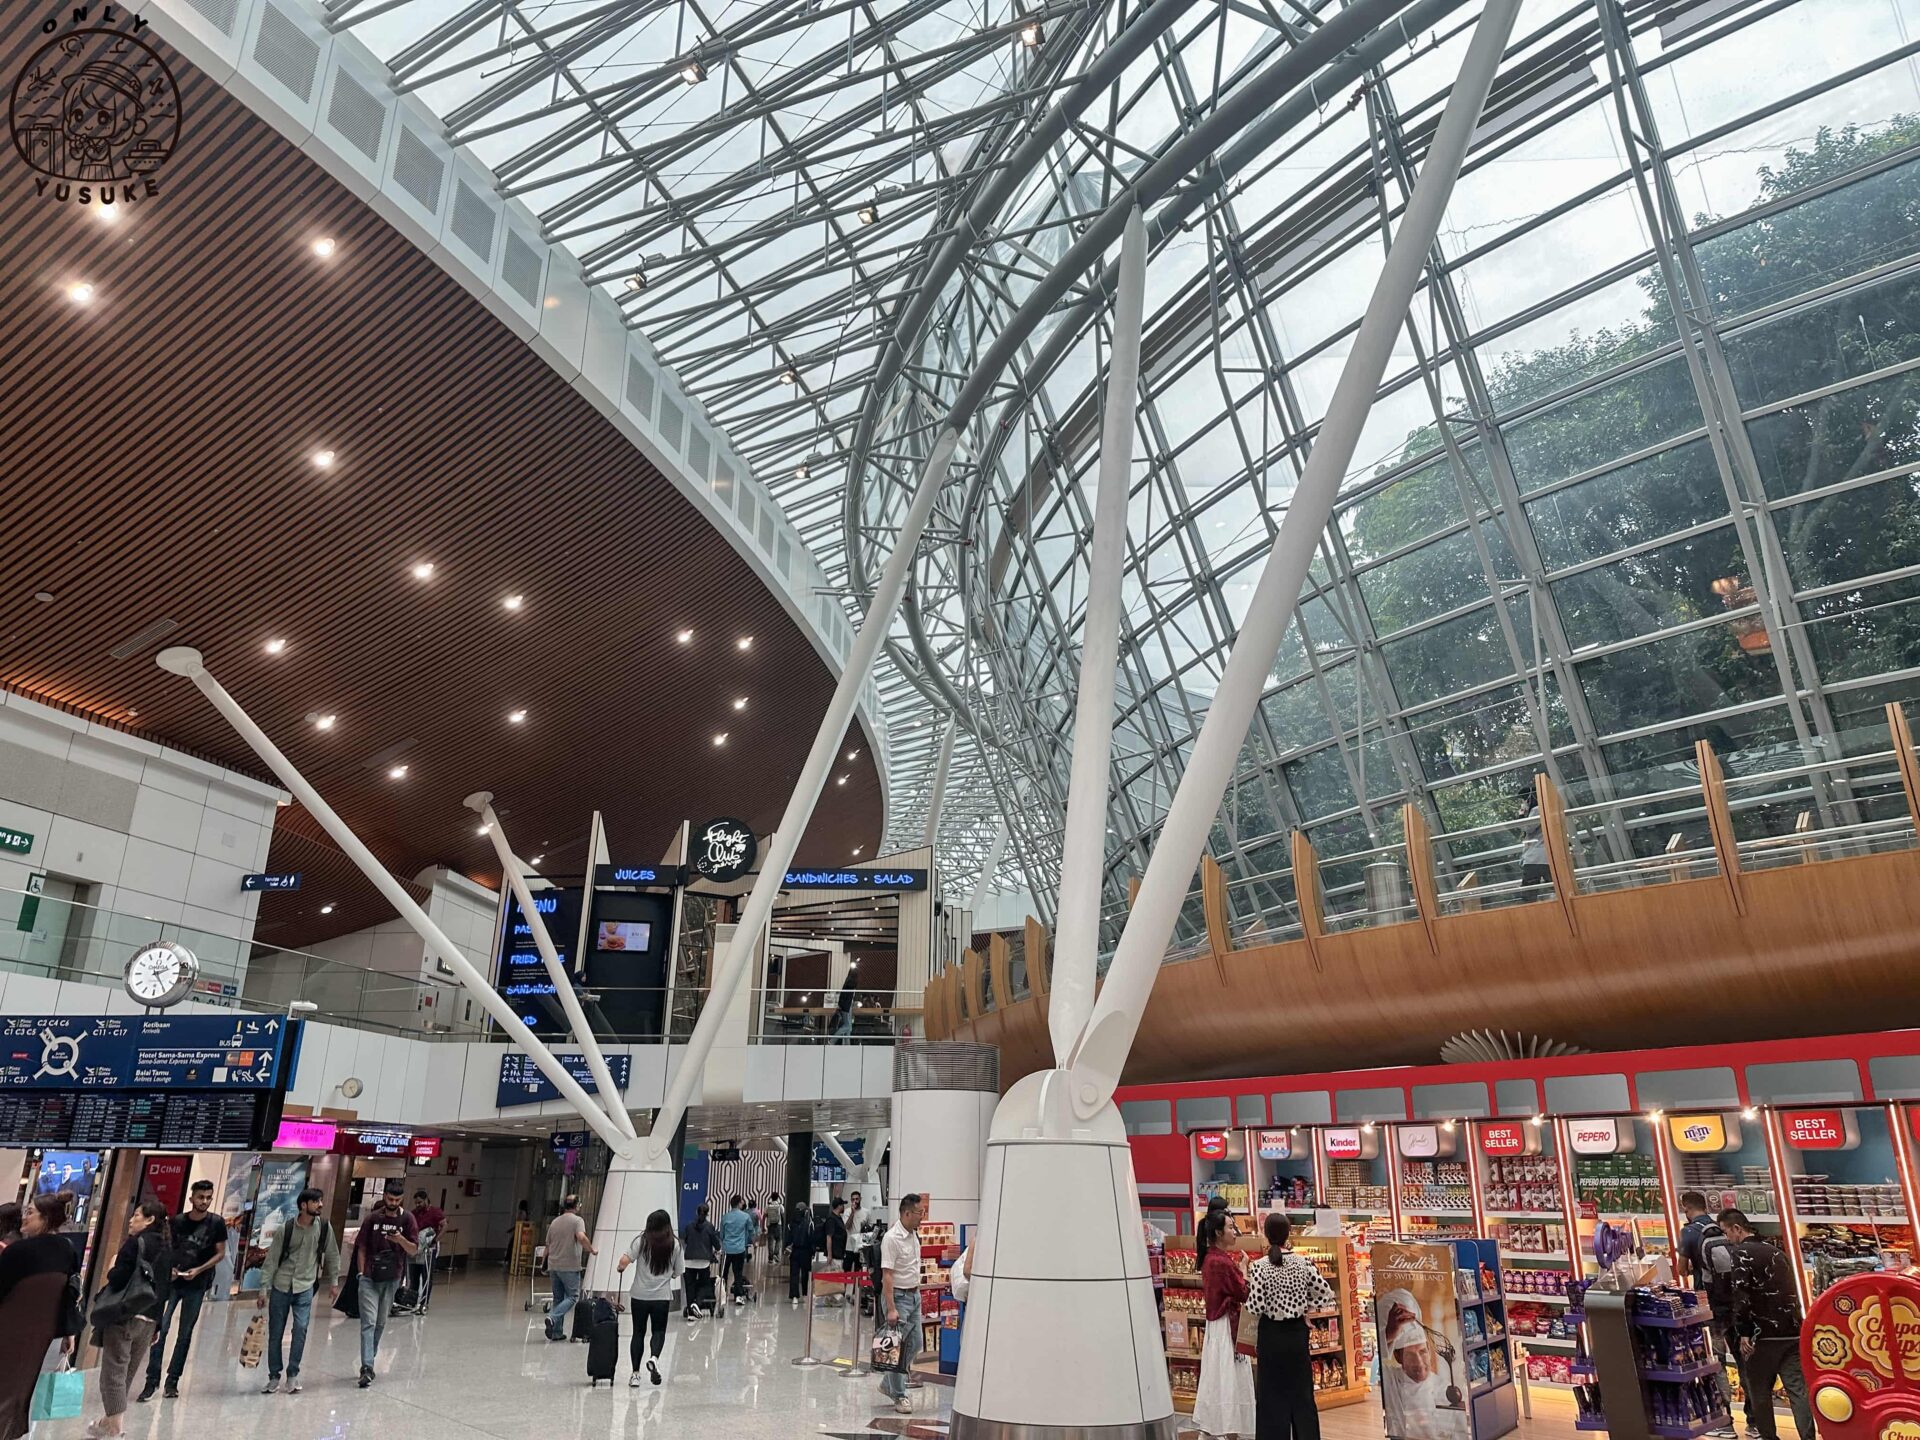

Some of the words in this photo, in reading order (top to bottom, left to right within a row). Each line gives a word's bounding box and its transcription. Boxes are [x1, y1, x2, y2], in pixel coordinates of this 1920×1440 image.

[703, 822, 750, 847] Flight
[708, 841, 740, 862] Club
[615, 869, 656, 880] JUICES
[785, 872, 858, 884] SANDWICHES
[874, 874, 914, 884] SALAD
[510, 954, 538, 964] FRIED
[4, 1028, 13, 1036] C1
[196, 1052, 220, 1060] Express
[14, 1076, 28, 1084] C37
[1795, 1118, 1826, 1129] BEST
[1489, 1130, 1511, 1139] BEST
[1577, 1132, 1611, 1142] PEPERO
[1790, 1130, 1837, 1140] SELLER
[358, 1135, 389, 1144] CURRENCY
[1485, 1139, 1519, 1148] SELLER
[160, 1166, 181, 1174] CIMB
[1580, 1178, 1599, 1186] PEPERO
[1600, 1178, 1619, 1186] PEPERO
[1620, 1178, 1640, 1186] PEPERO
[1641, 1178, 1660, 1186] PEPER
[1386, 1254, 1428, 1270] Lindt
[1382, 1272, 1391, 1280] OF
[1394, 1273, 1444, 1281] SWITZERLAND
[1346, 1243, 1366, 1382] TOBLERONE
